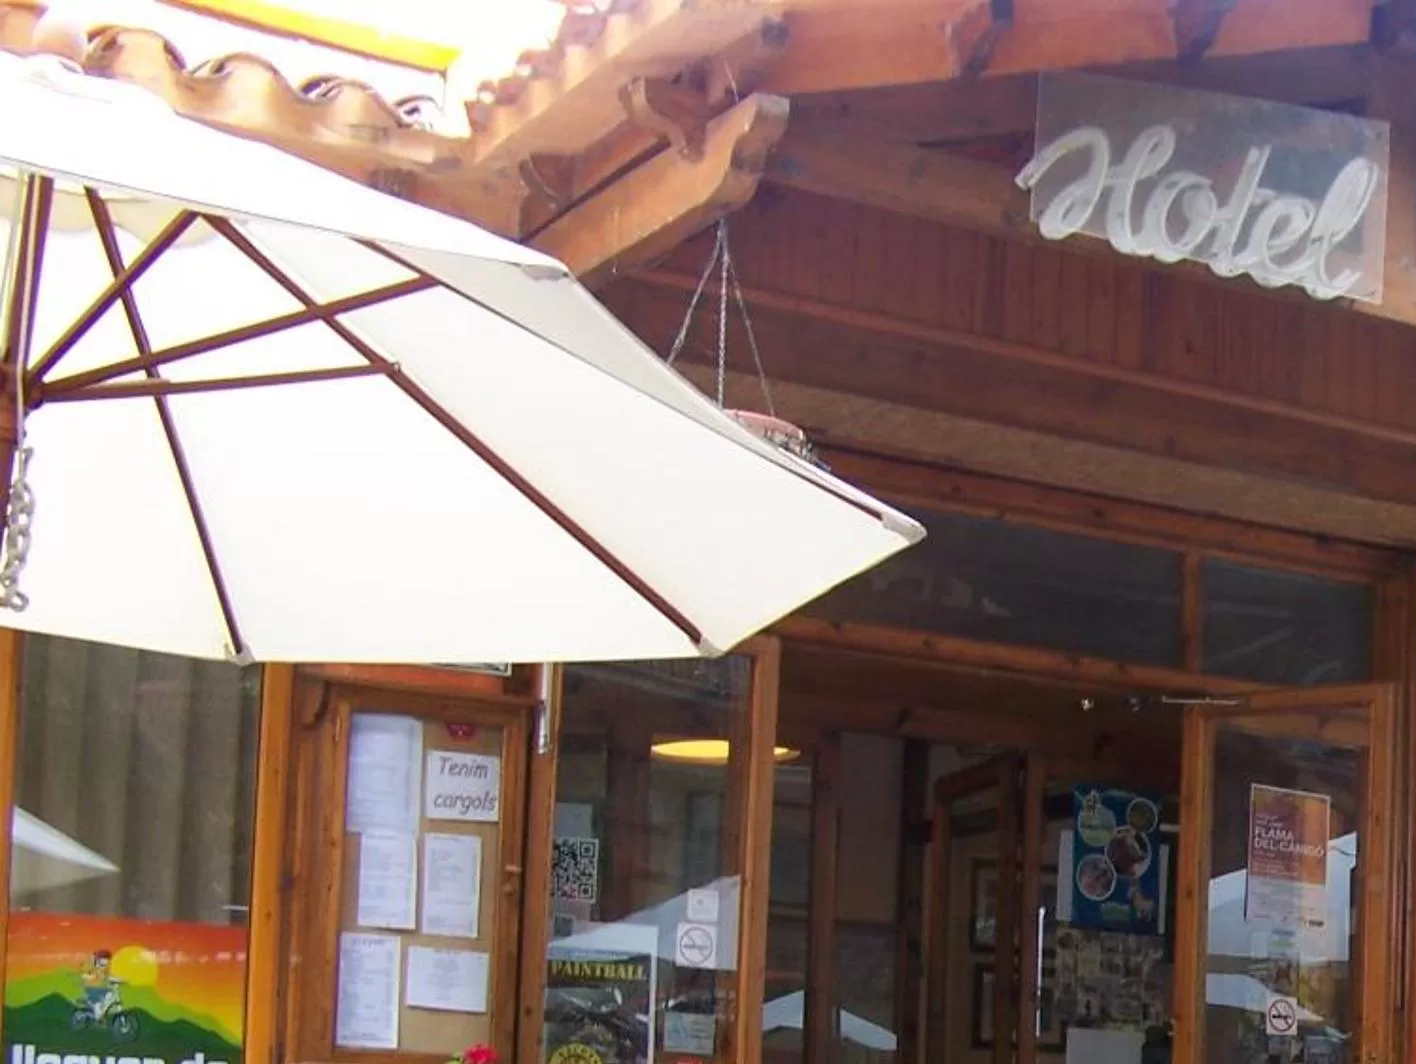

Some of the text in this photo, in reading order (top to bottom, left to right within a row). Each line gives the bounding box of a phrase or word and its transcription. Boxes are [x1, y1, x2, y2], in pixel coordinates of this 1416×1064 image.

[1014, 124, 1379, 300] Hotel
[440, 756, 489, 779] Tenim
[433, 790, 498, 815] cargols
[1254, 826, 1295, 841] FLAMA
[1254, 837, 1277, 851] DEL
[551, 959, 646, 982] PAINTBALL
